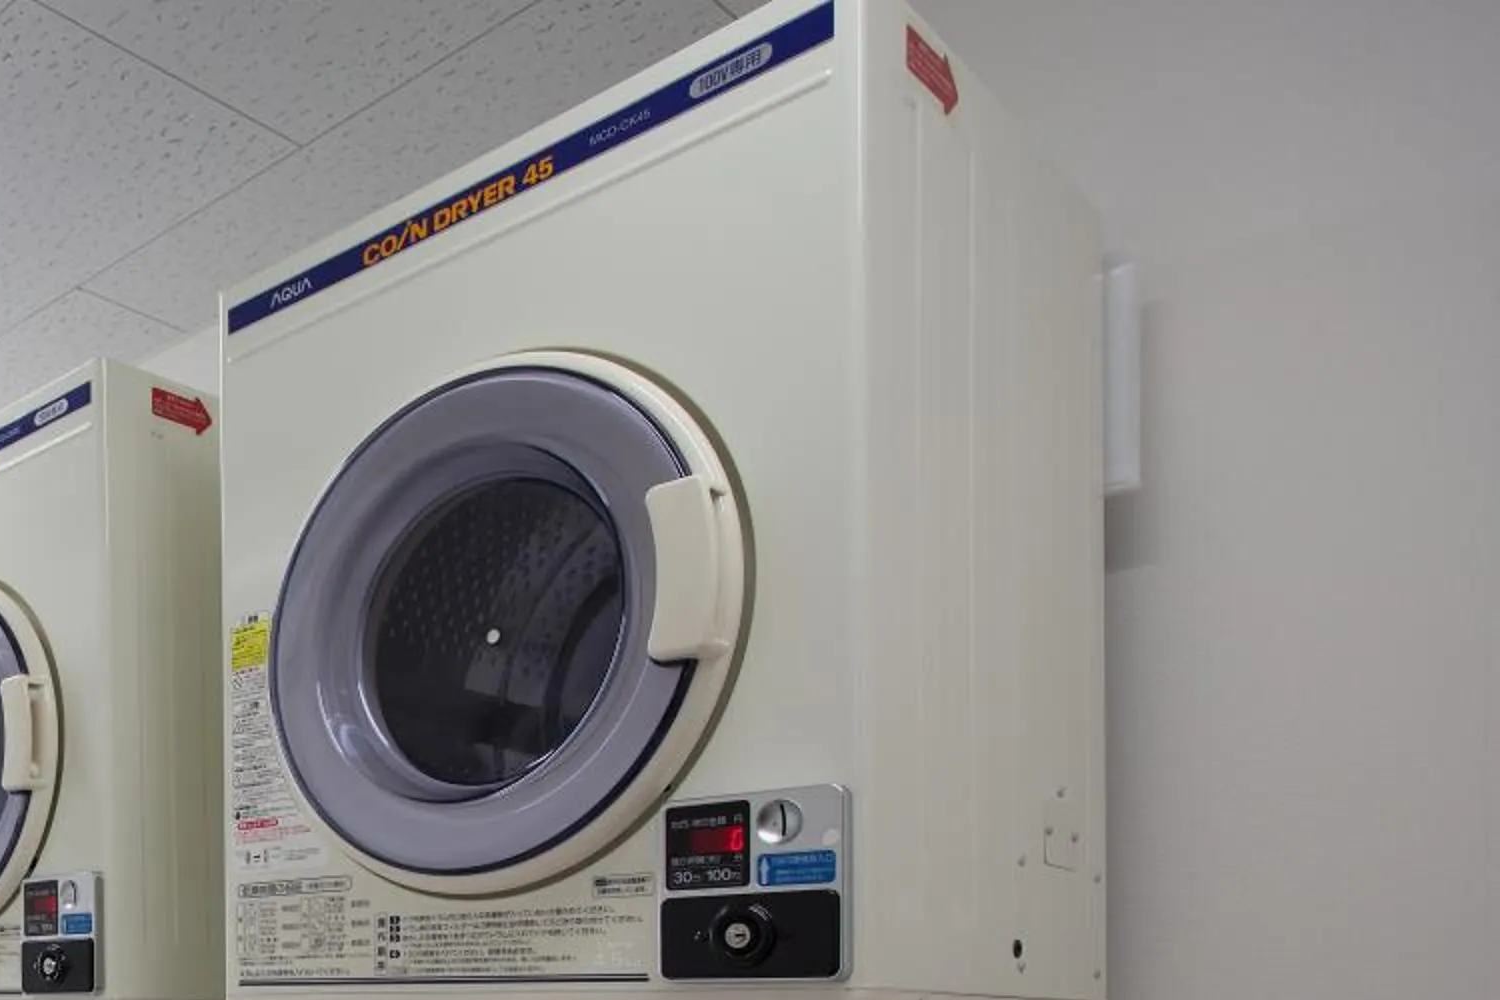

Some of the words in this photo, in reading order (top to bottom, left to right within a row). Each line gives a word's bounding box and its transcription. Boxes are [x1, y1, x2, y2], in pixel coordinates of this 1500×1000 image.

[269, 277, 313, 309] AQUA
[432, 174, 517, 232] DRYER
[521, 156, 555, 186] 45
[730, 827, 744, 851] 0
